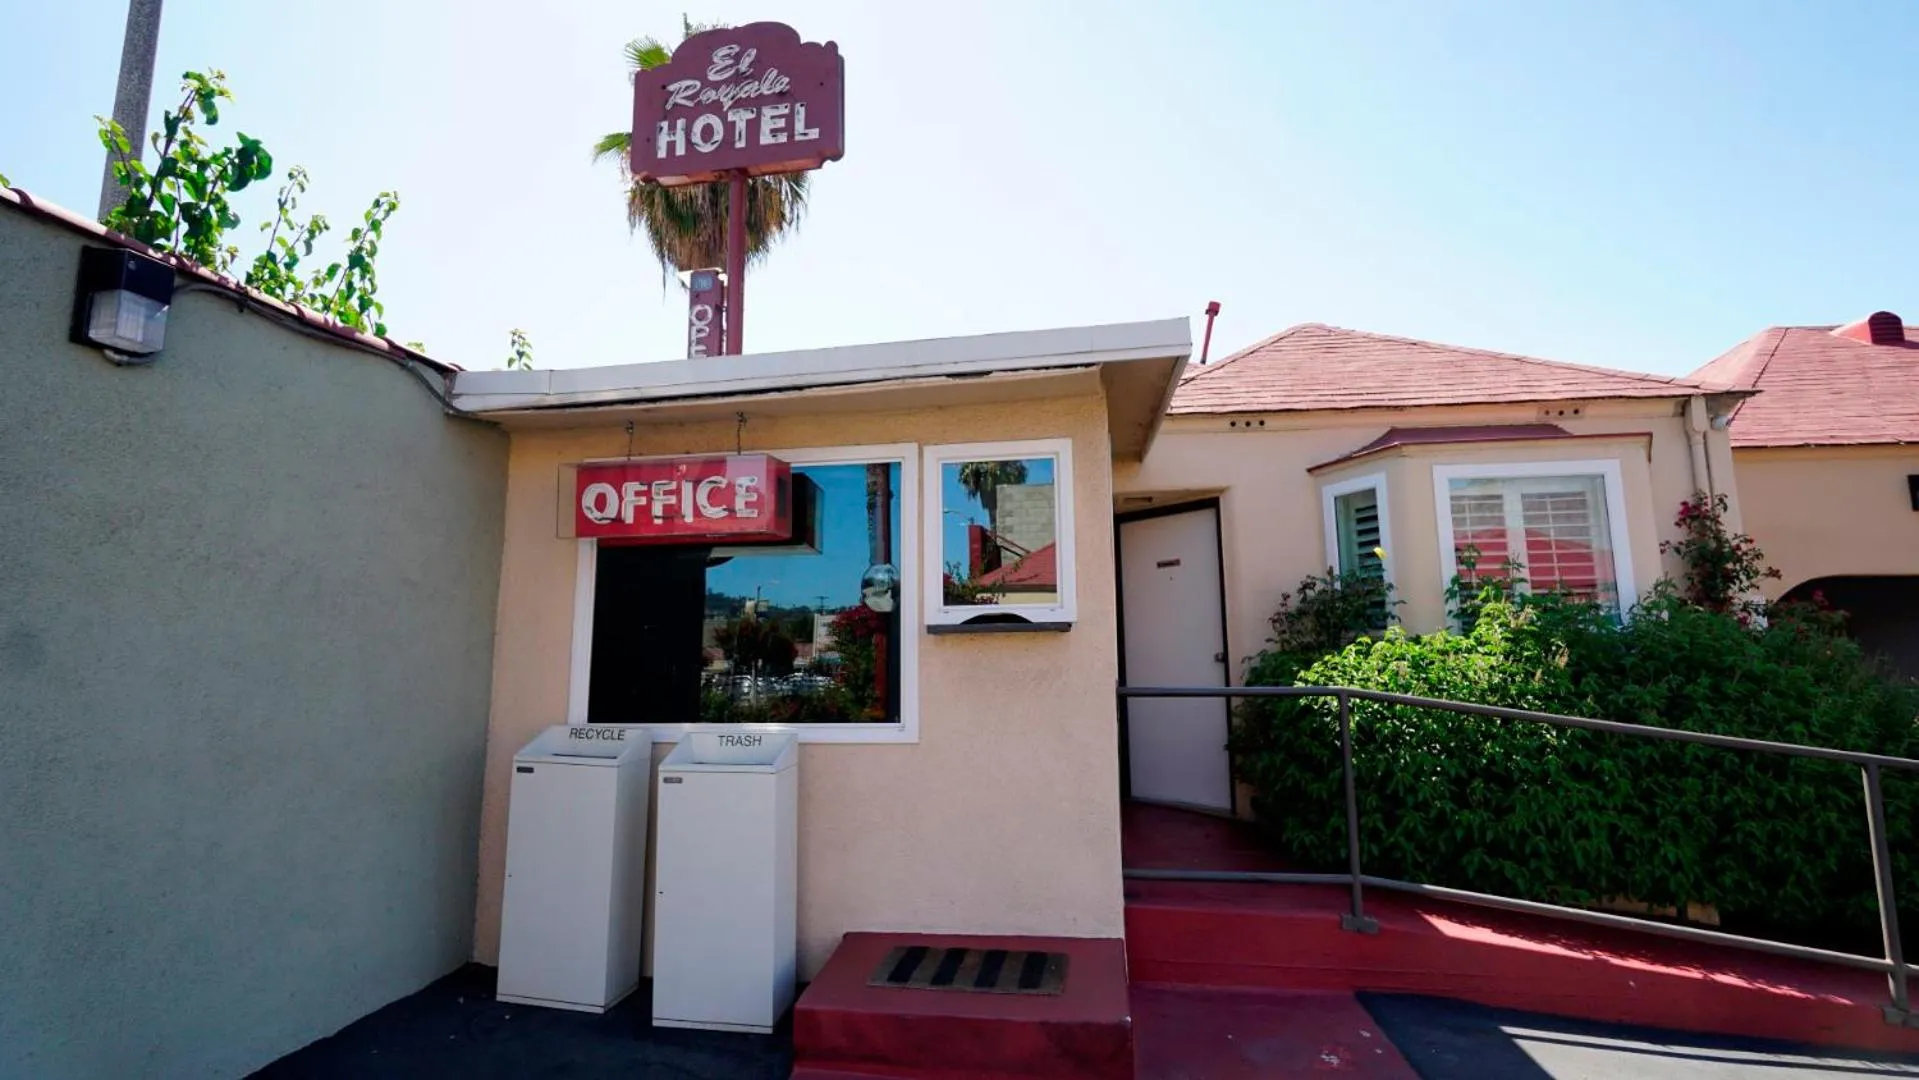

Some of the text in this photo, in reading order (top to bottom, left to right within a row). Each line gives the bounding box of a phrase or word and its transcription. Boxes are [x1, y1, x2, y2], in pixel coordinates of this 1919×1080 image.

[706, 44, 754, 81] El
[656, 102, 820, 159] HOTEL
[581, 475, 759, 524] OFFICE
[568, 727, 626, 741] RECYCLE
[717, 735, 762, 747] TRASH
